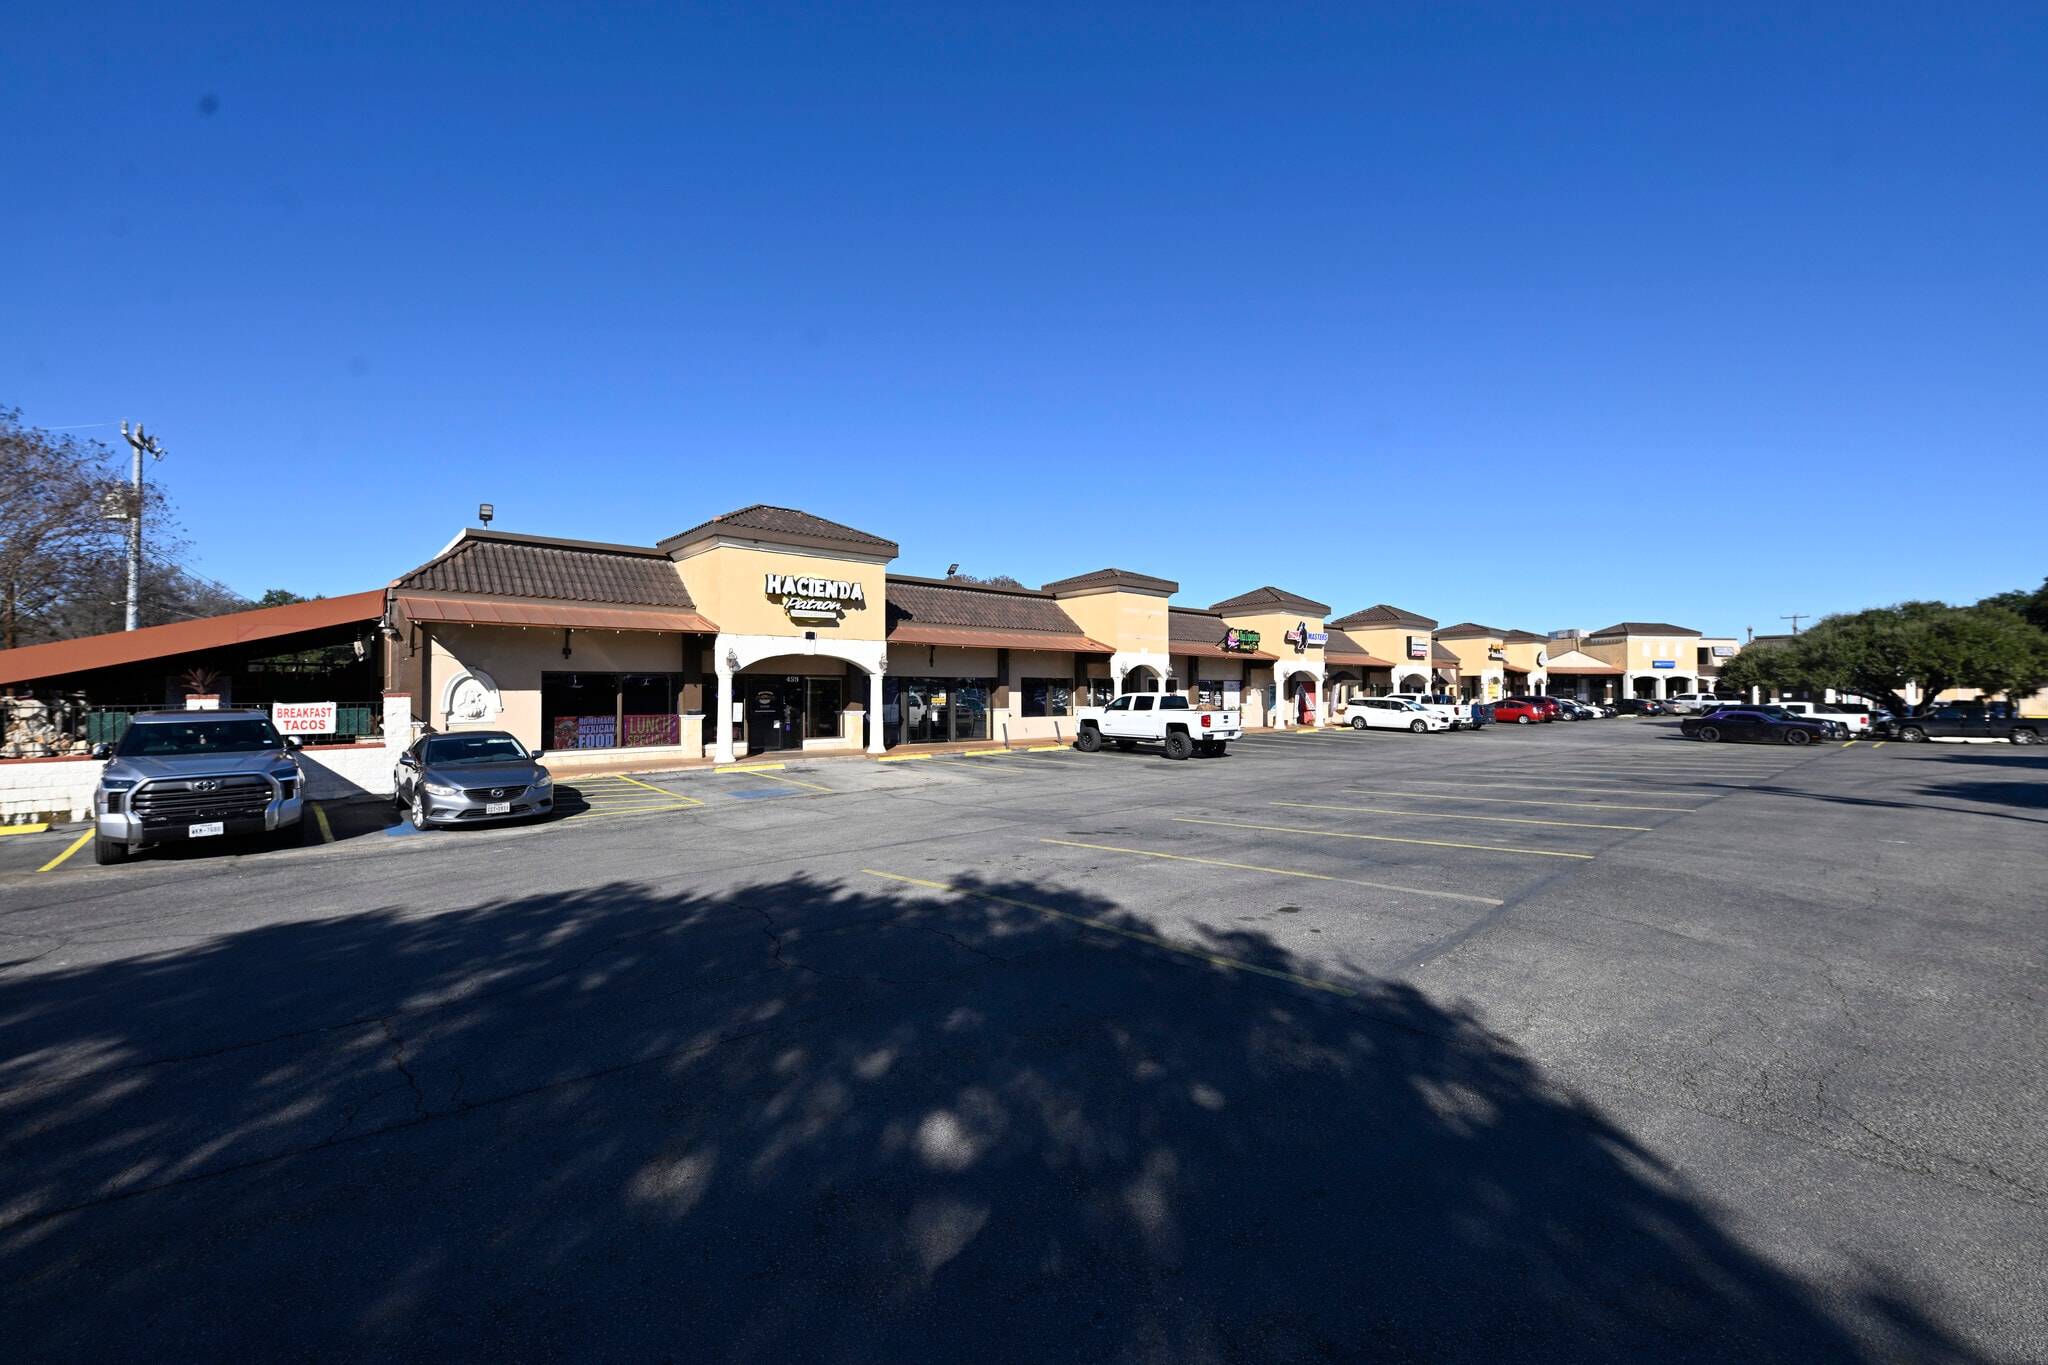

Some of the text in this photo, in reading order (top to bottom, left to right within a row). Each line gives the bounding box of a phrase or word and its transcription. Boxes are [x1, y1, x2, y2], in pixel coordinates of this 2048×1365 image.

[766, 573, 863, 601] HACIENDA
[785, 597, 842, 610] Patron
[277, 707, 333, 719] BREAKFAST
[283, 720, 326, 731] TACOS
[579, 716, 615, 725] HOMEMADE
[629, 716, 671, 735] LUNCH
[579, 725, 615, 734] MEXICAN
[579, 733, 615, 749] FOOD
[627, 733, 672, 747] SPECIALS
